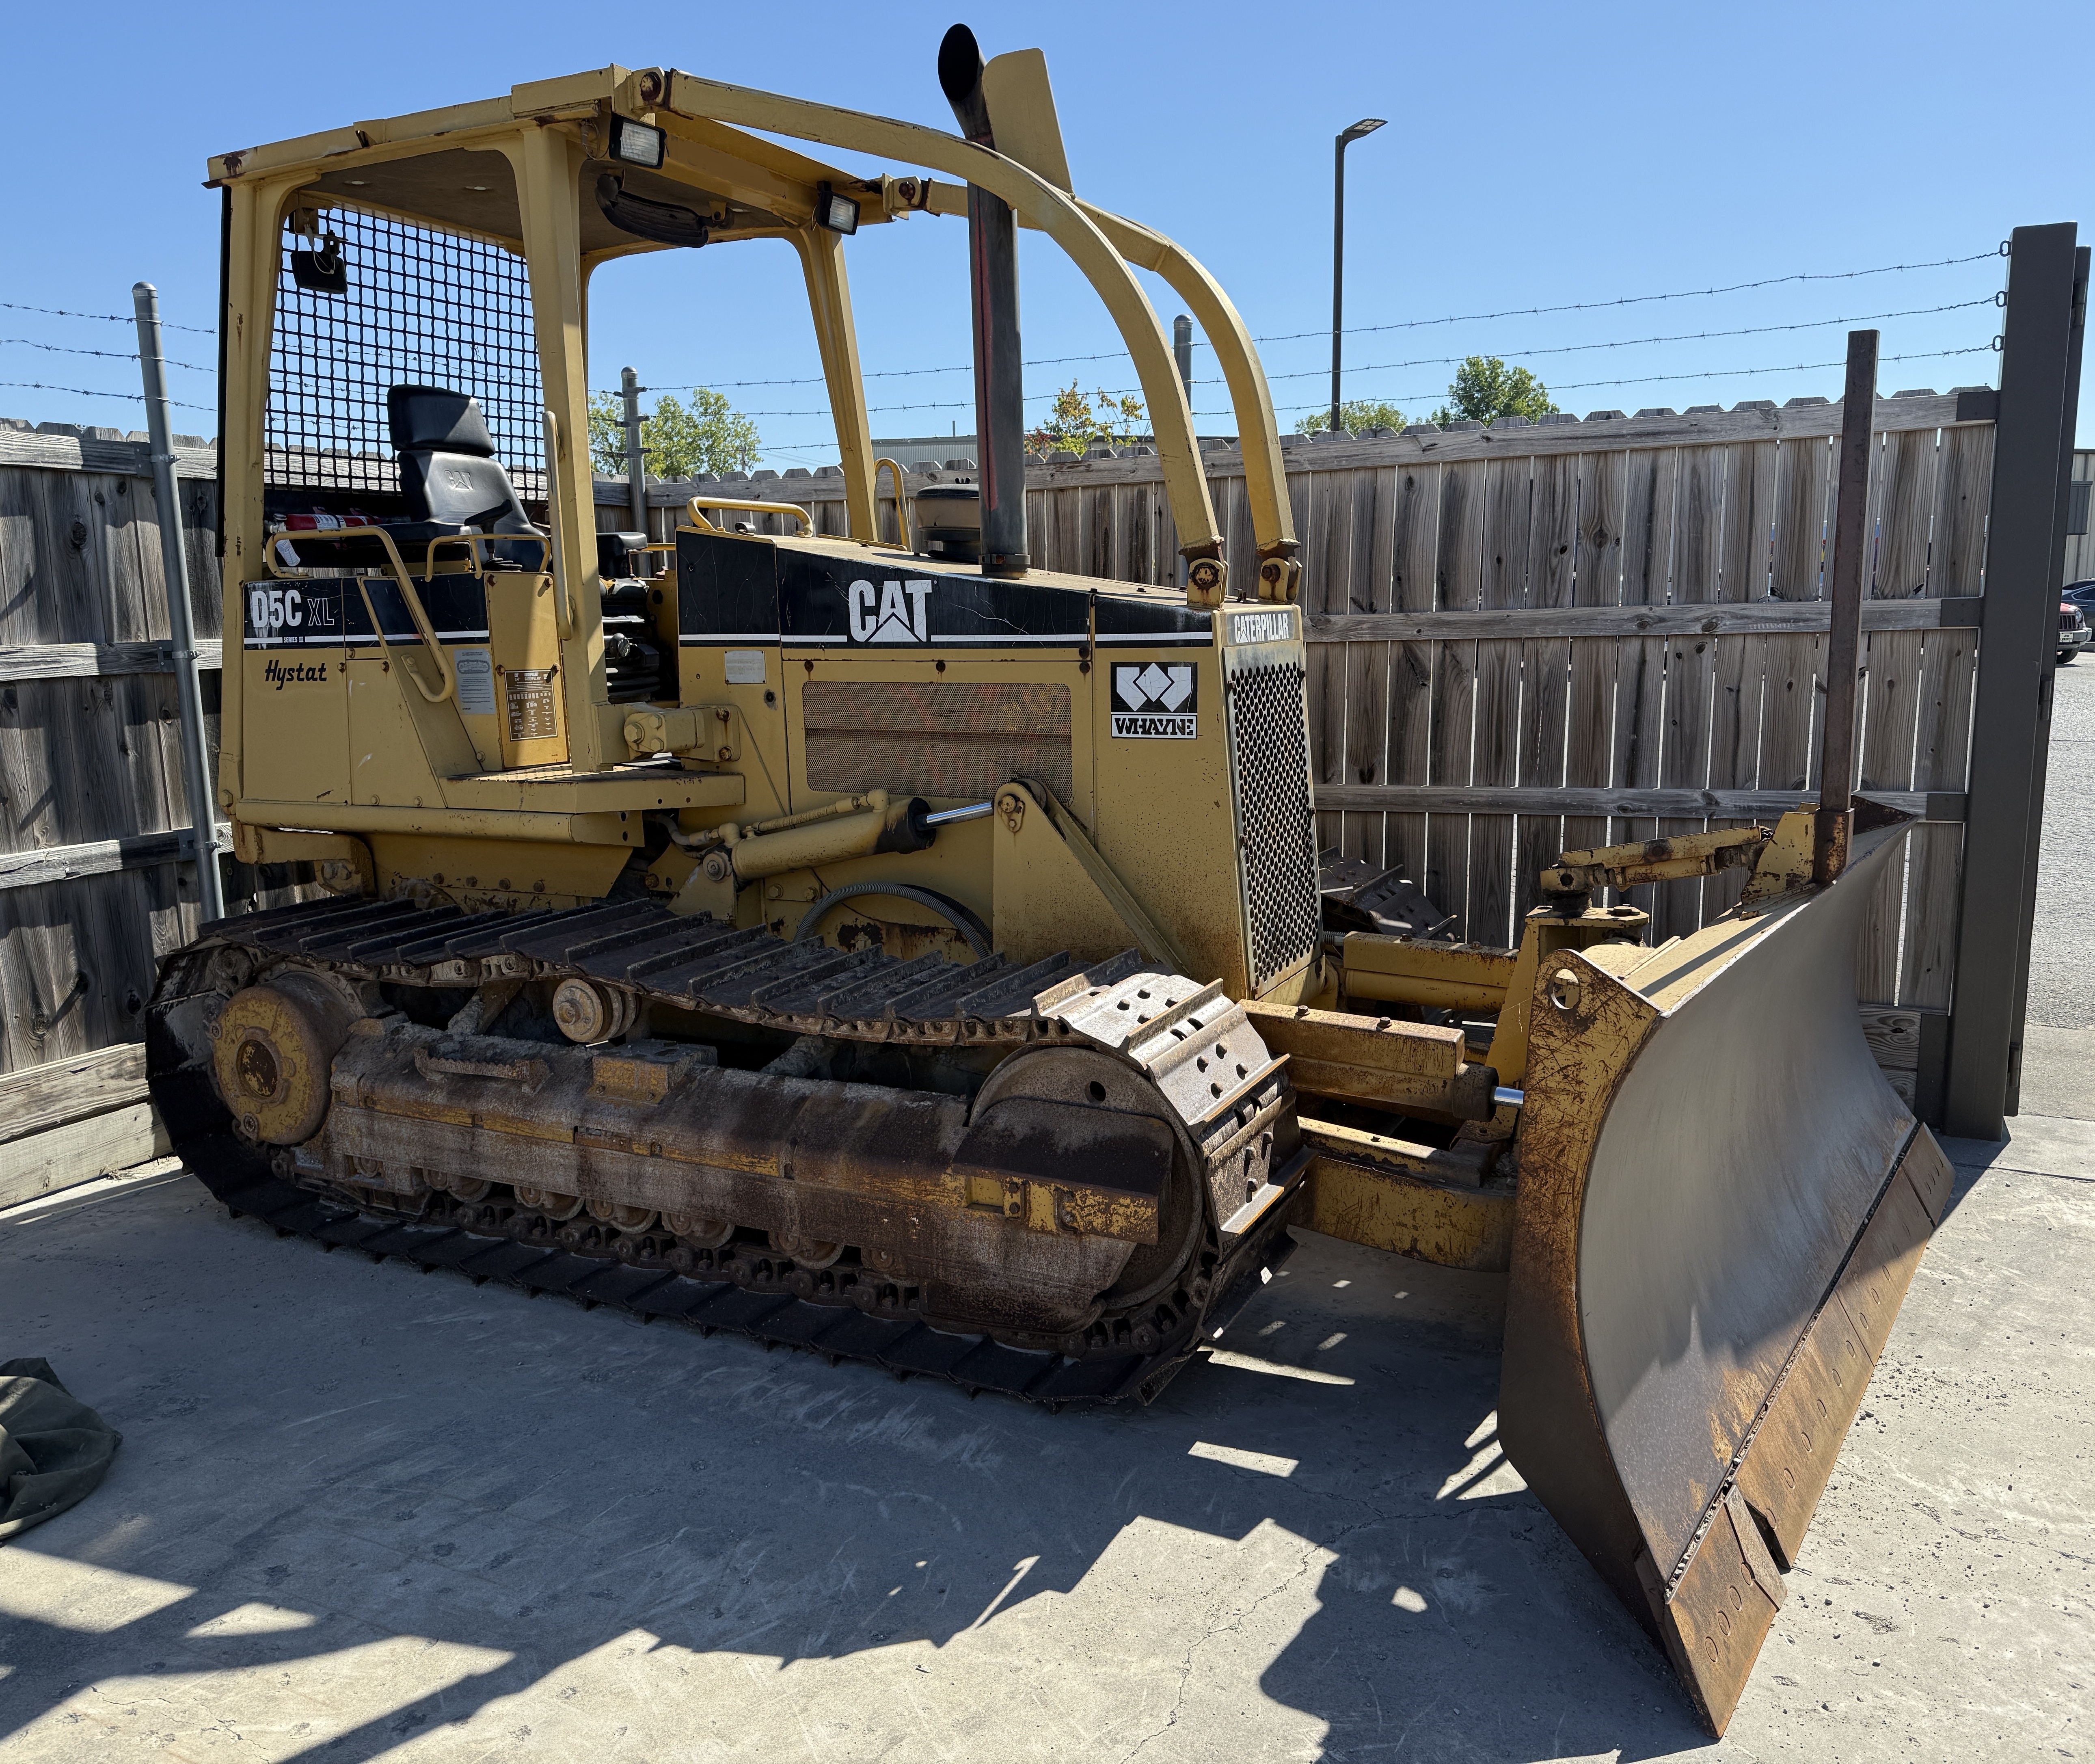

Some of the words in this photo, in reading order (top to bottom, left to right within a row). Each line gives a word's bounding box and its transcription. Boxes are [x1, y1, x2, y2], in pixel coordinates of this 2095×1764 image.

[444, 469, 473, 491] CAT
[251, 589, 302, 628] D5C
[307, 598, 335, 626] XL
[849, 580, 932, 642] CAT
[1234, 613, 1289, 643] CATERPILLAR
[265, 659, 327, 690] Hystat
[1114, 718, 1193, 735] WHAYNE
